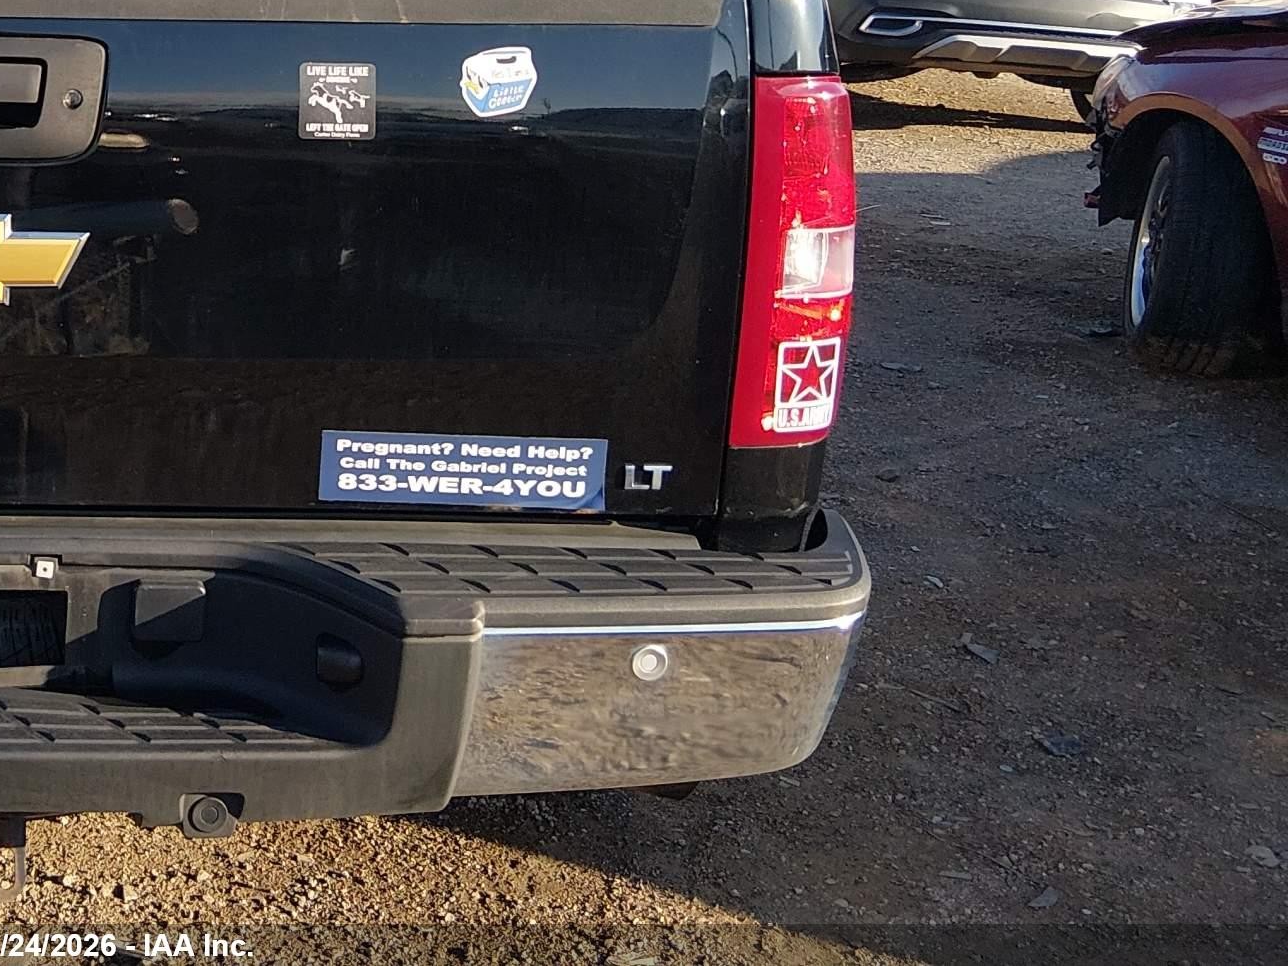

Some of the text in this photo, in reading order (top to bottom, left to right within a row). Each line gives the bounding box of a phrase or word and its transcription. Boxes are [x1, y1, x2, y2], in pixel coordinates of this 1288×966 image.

[307, 66, 369, 76] LIVE LIFE LIKE
[336, 439, 593, 462] Pregnant? Need Help?
[340, 457, 588, 478] Call The Gabriel Project
[623, 464, 674, 491] LT
[337, 473, 586, 498] 833-WER-4YOU
